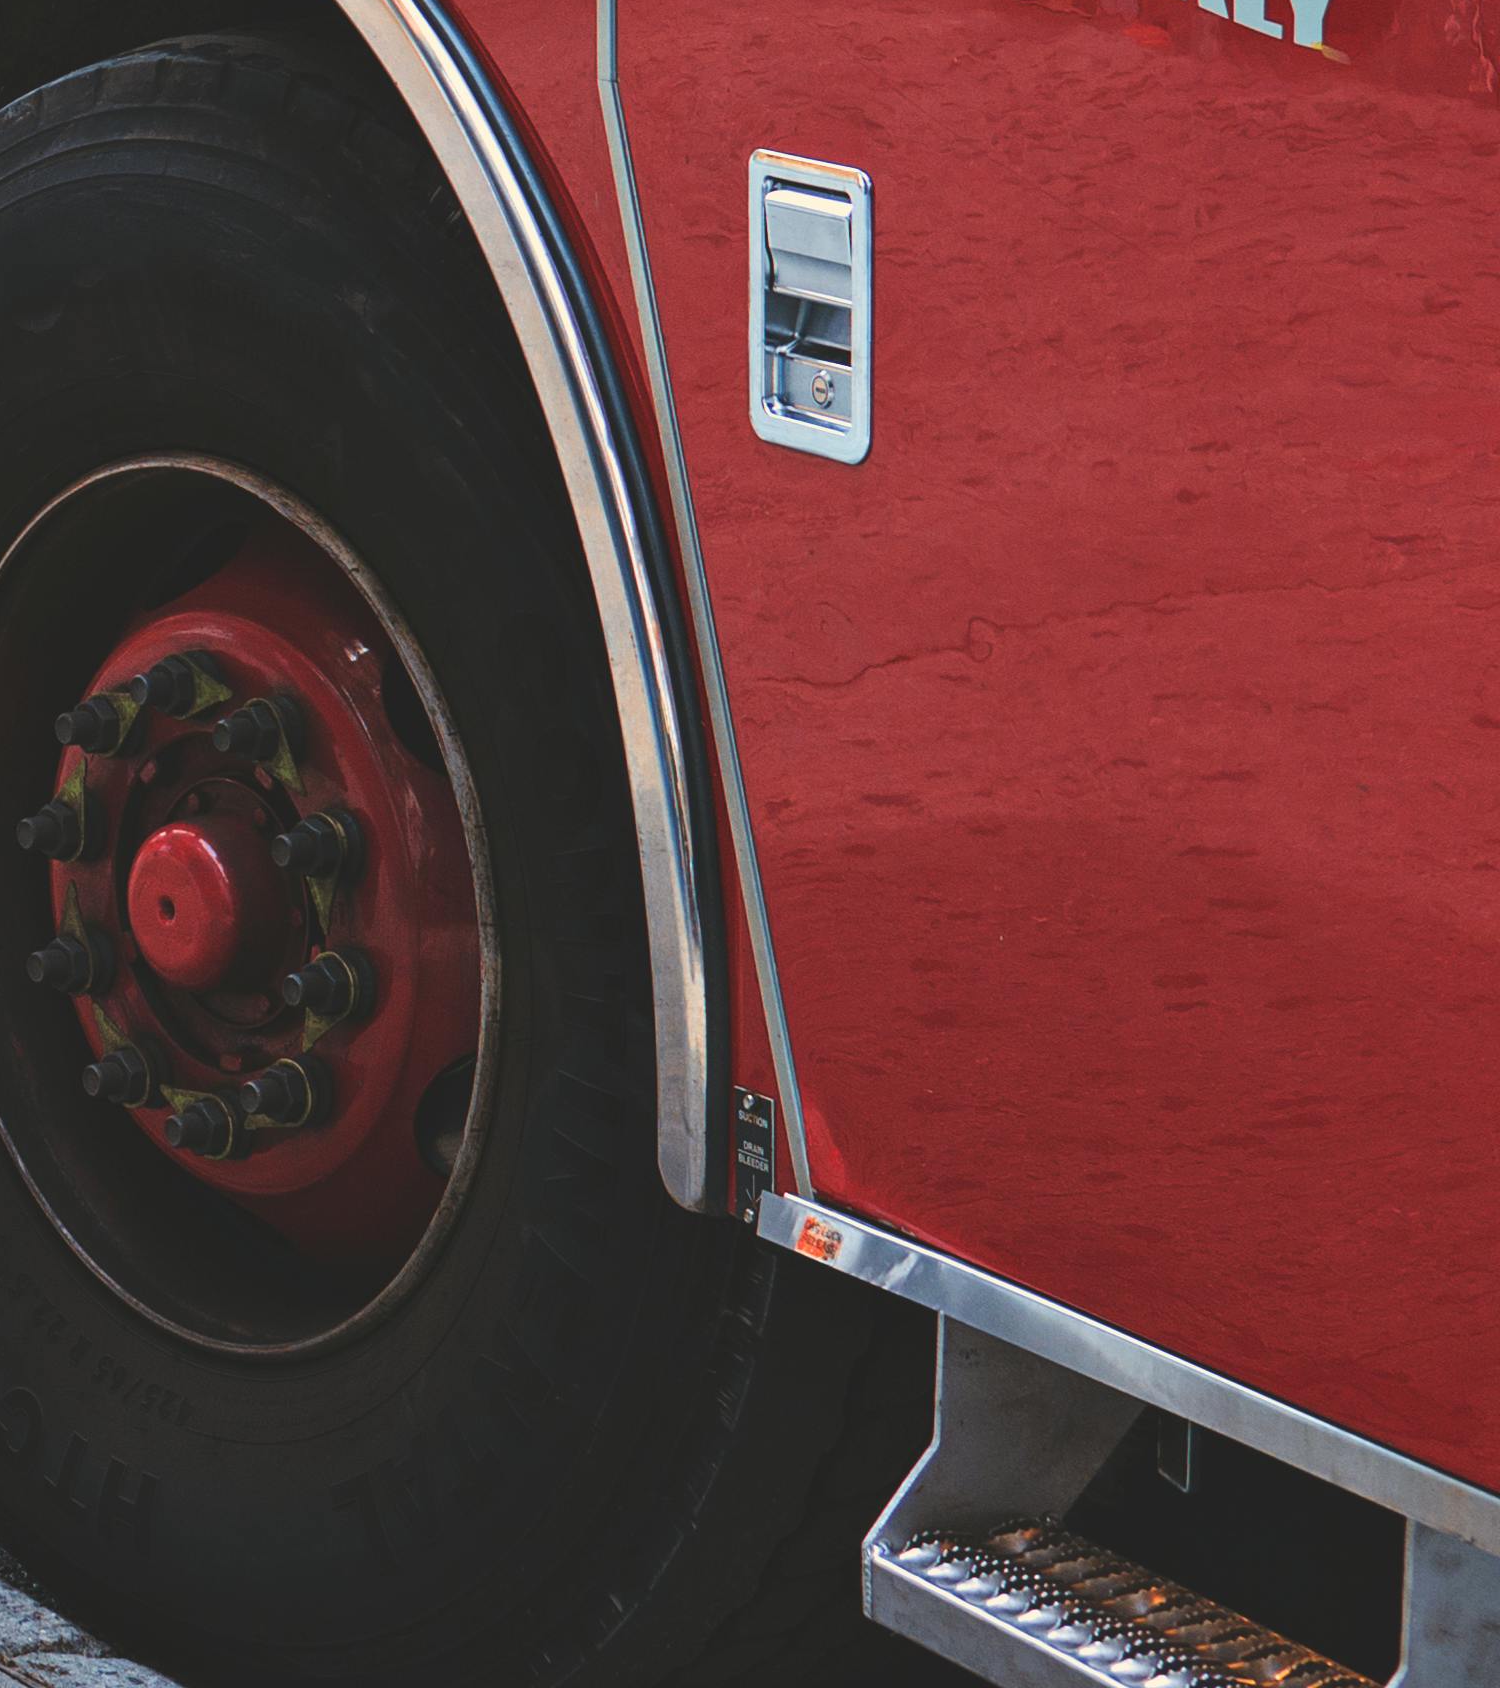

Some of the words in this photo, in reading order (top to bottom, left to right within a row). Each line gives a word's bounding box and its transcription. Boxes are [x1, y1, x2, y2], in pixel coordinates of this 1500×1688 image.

[738, 1110, 768, 1129] SUCTION
[743, 1140, 765, 1156] DRAIN
[738, 1152, 770, 1173] BLEEDER
